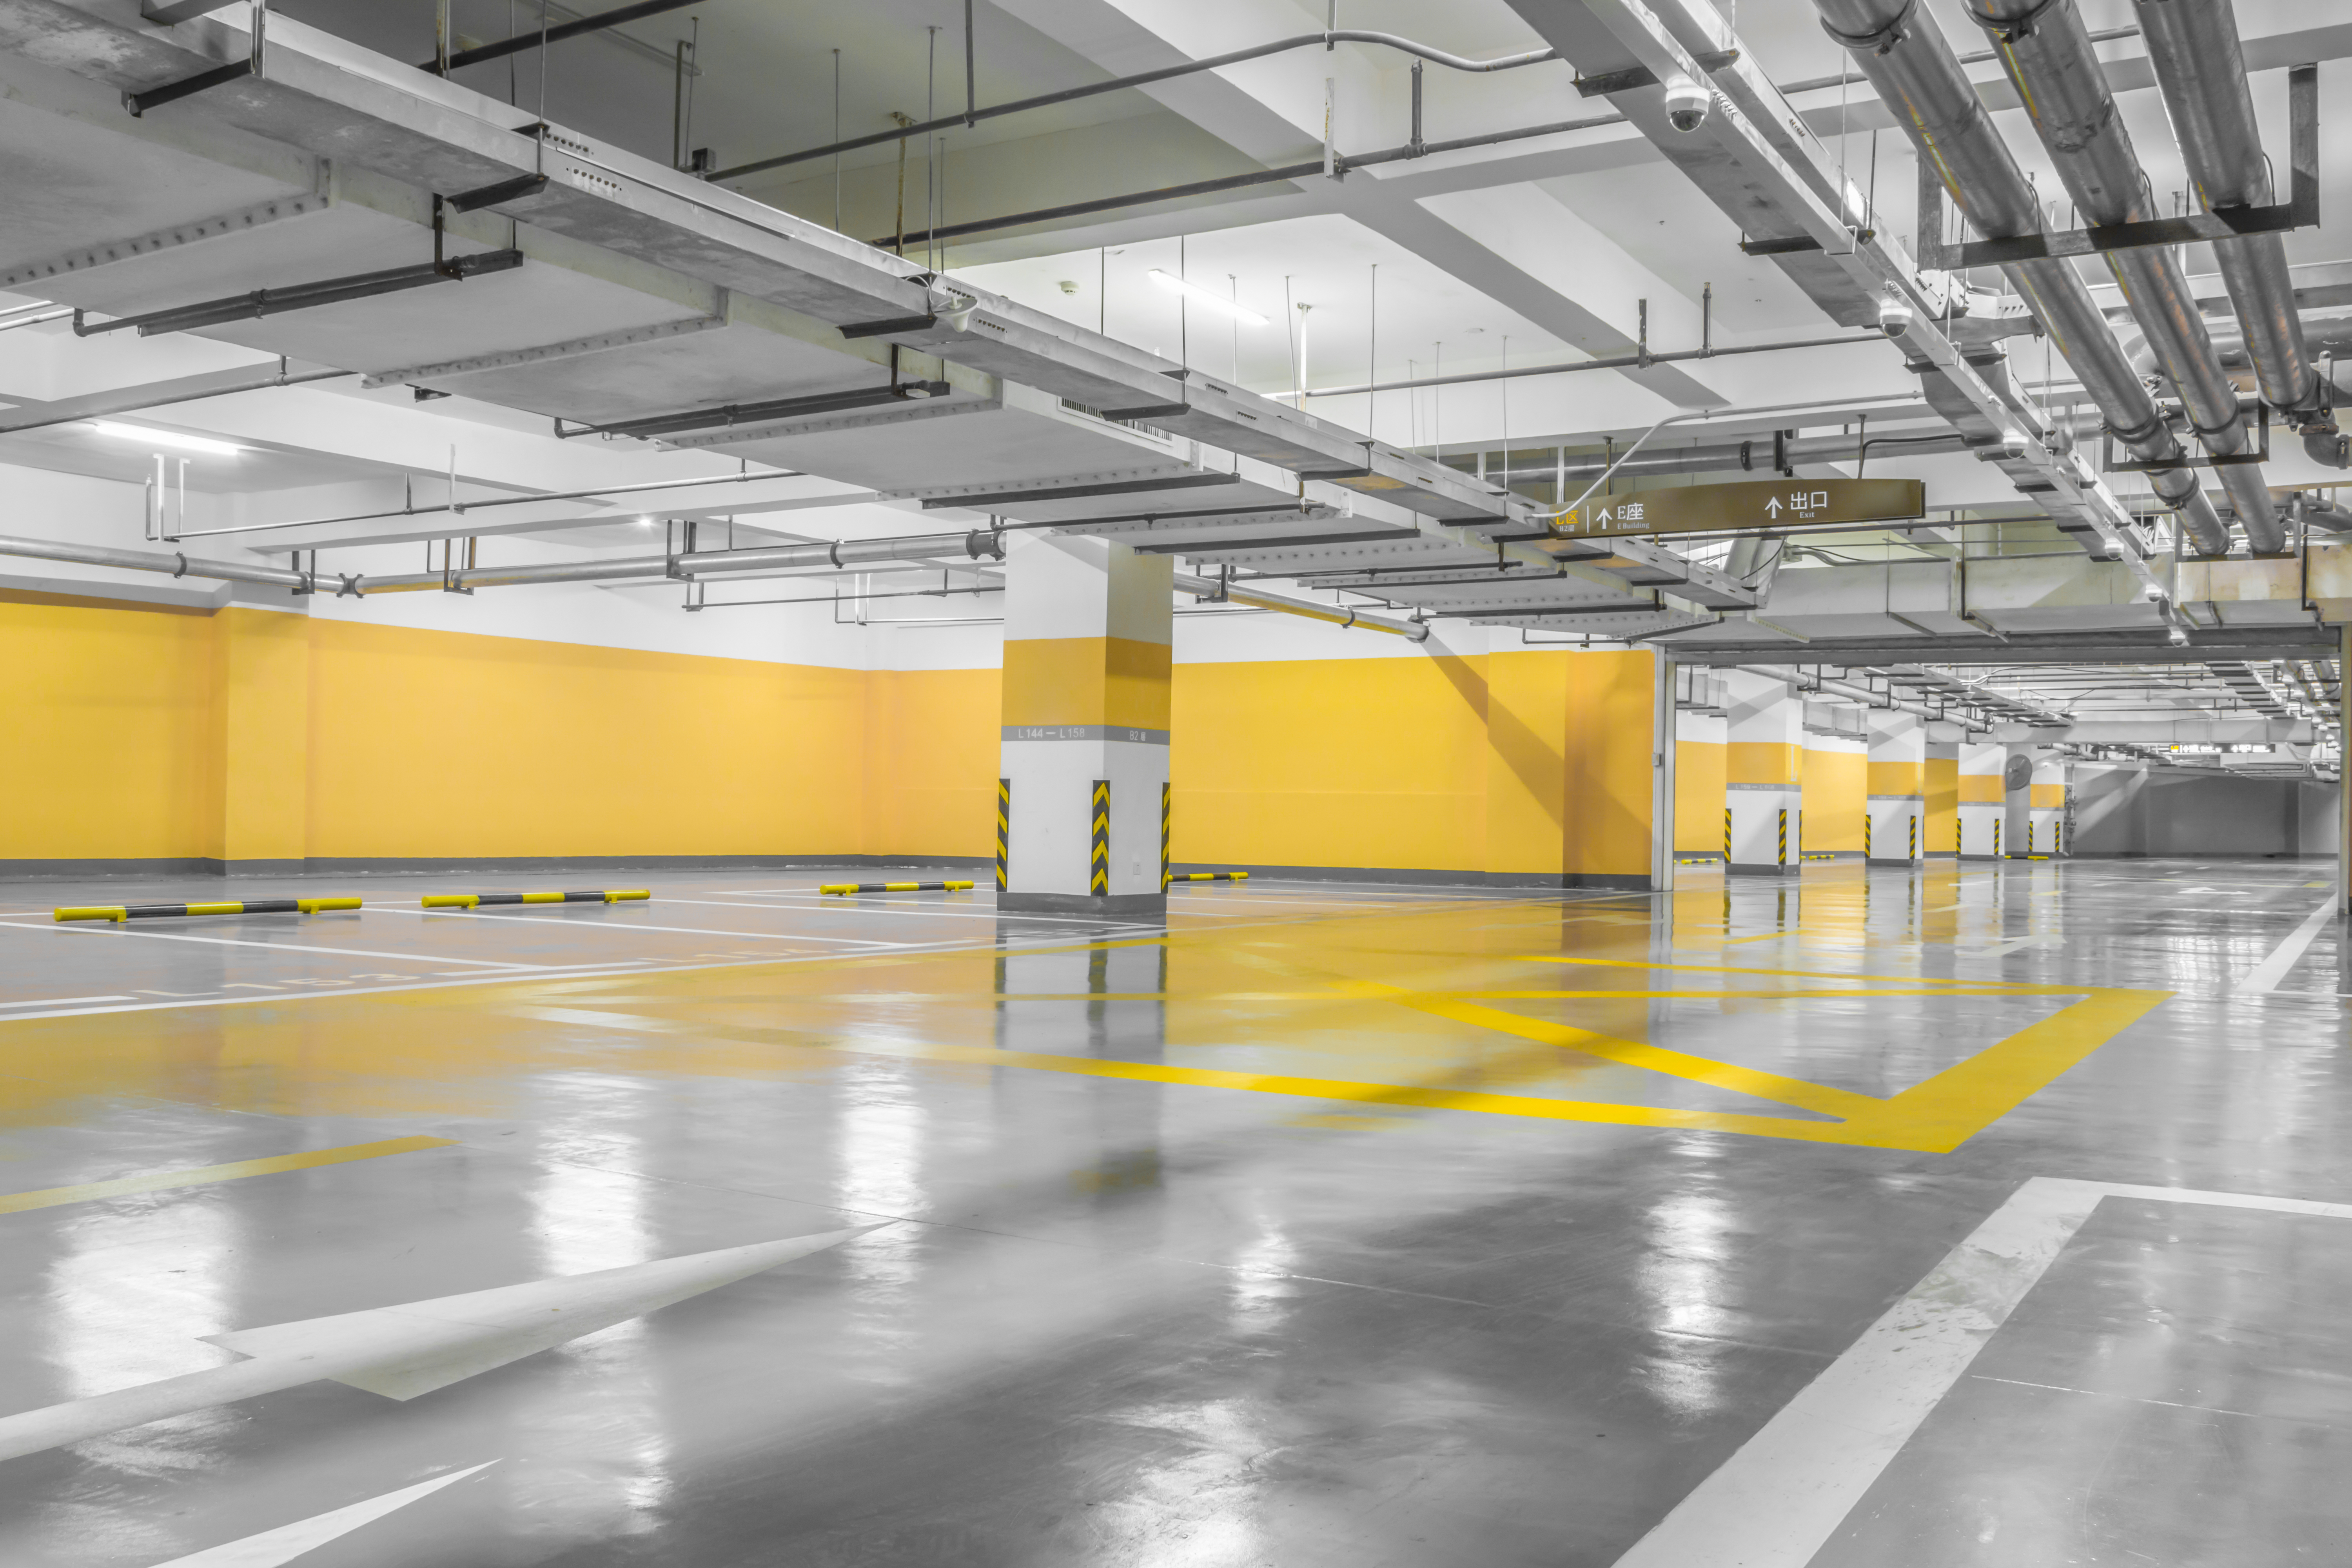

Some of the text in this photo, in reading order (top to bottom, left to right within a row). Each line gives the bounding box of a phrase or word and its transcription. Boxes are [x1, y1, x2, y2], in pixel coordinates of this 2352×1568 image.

[1791, 492, 1827, 510] 出口
[1555, 510, 1579, 525] L区
[1617, 503, 1644, 520] E座
[130, 973, 421, 997] L153
